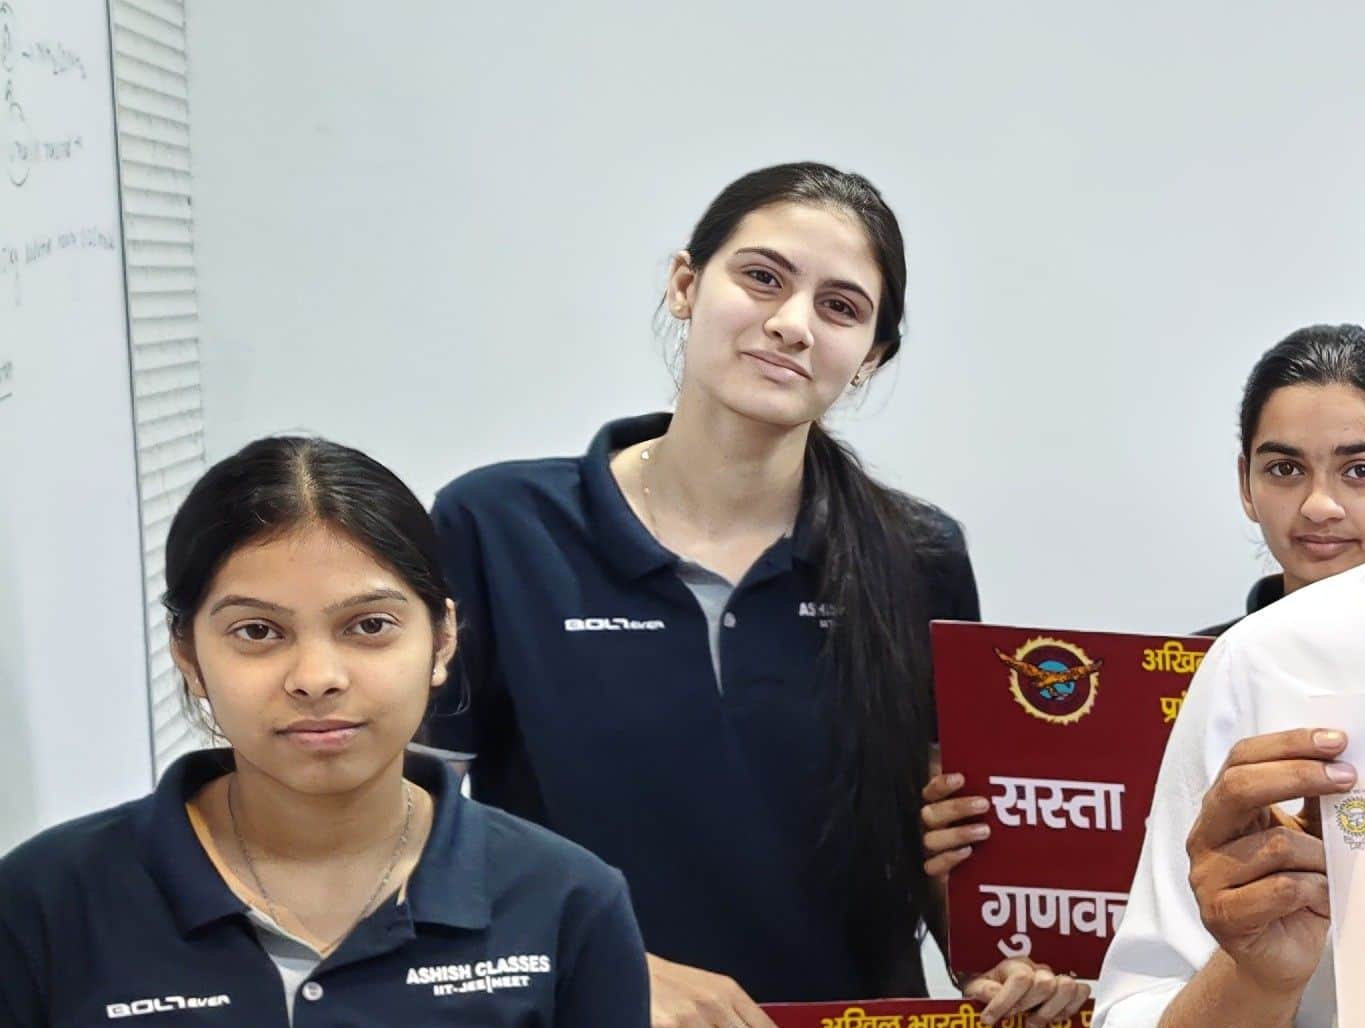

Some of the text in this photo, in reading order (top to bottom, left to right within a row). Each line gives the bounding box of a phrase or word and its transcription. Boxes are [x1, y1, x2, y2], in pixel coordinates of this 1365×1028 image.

[1141, 640, 1206, 673] अखि
[989, 776, 1125, 831] सस्ता
[979, 884, 1128, 958] गुणव
[405, 954, 552, 986] ASHISH CLASSES
